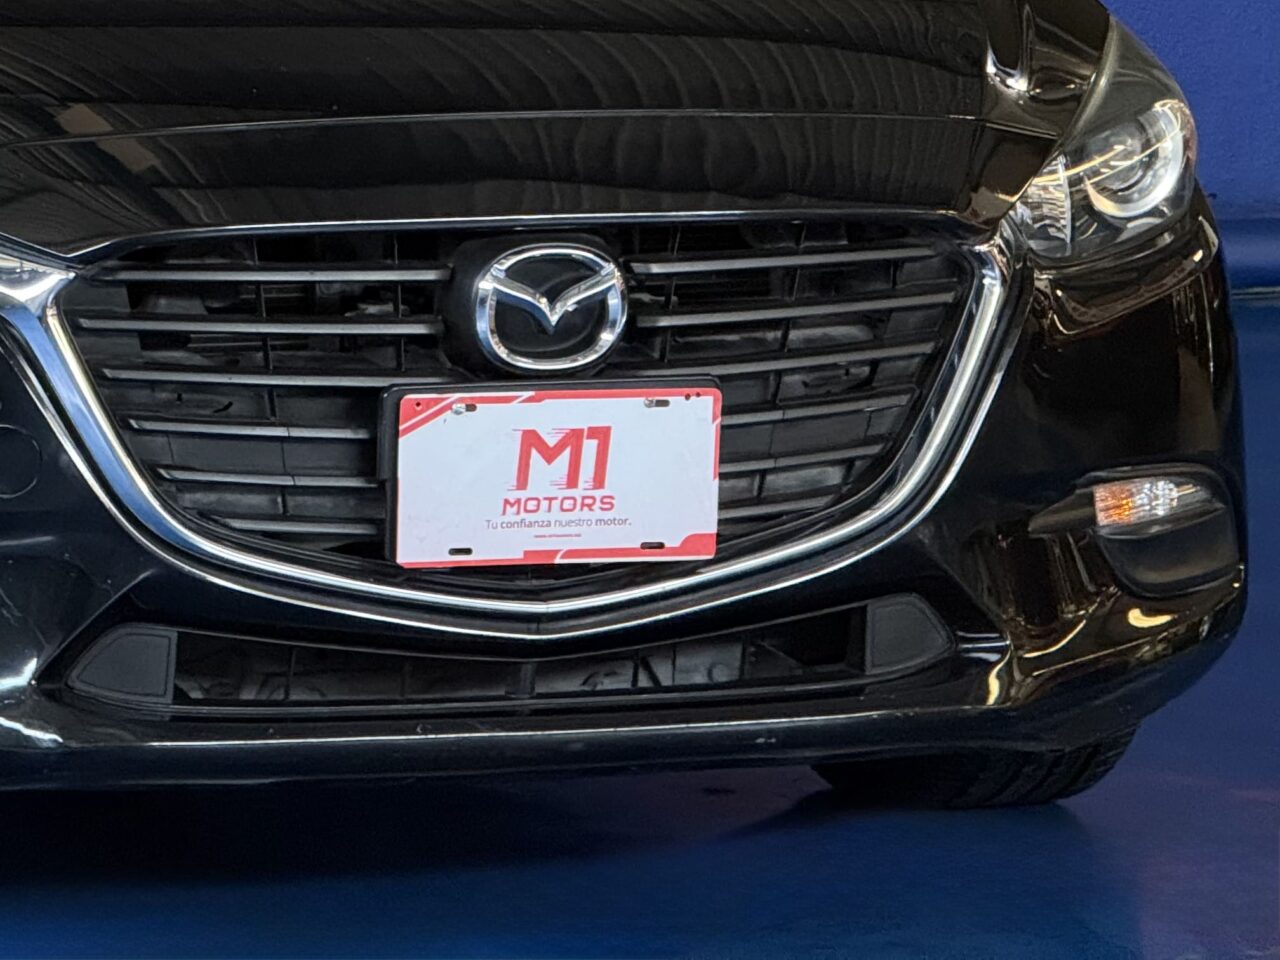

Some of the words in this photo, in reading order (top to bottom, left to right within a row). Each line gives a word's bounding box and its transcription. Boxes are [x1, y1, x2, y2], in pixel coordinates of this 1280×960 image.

[508, 425, 612, 491] M1
[501, 495, 616, 516] MOTORS
[485, 519, 498, 530] Tu
[500, 518, 552, 530] confianza
[554, 517, 593, 528] nuestro
[595, 517, 632, 527] motor.
